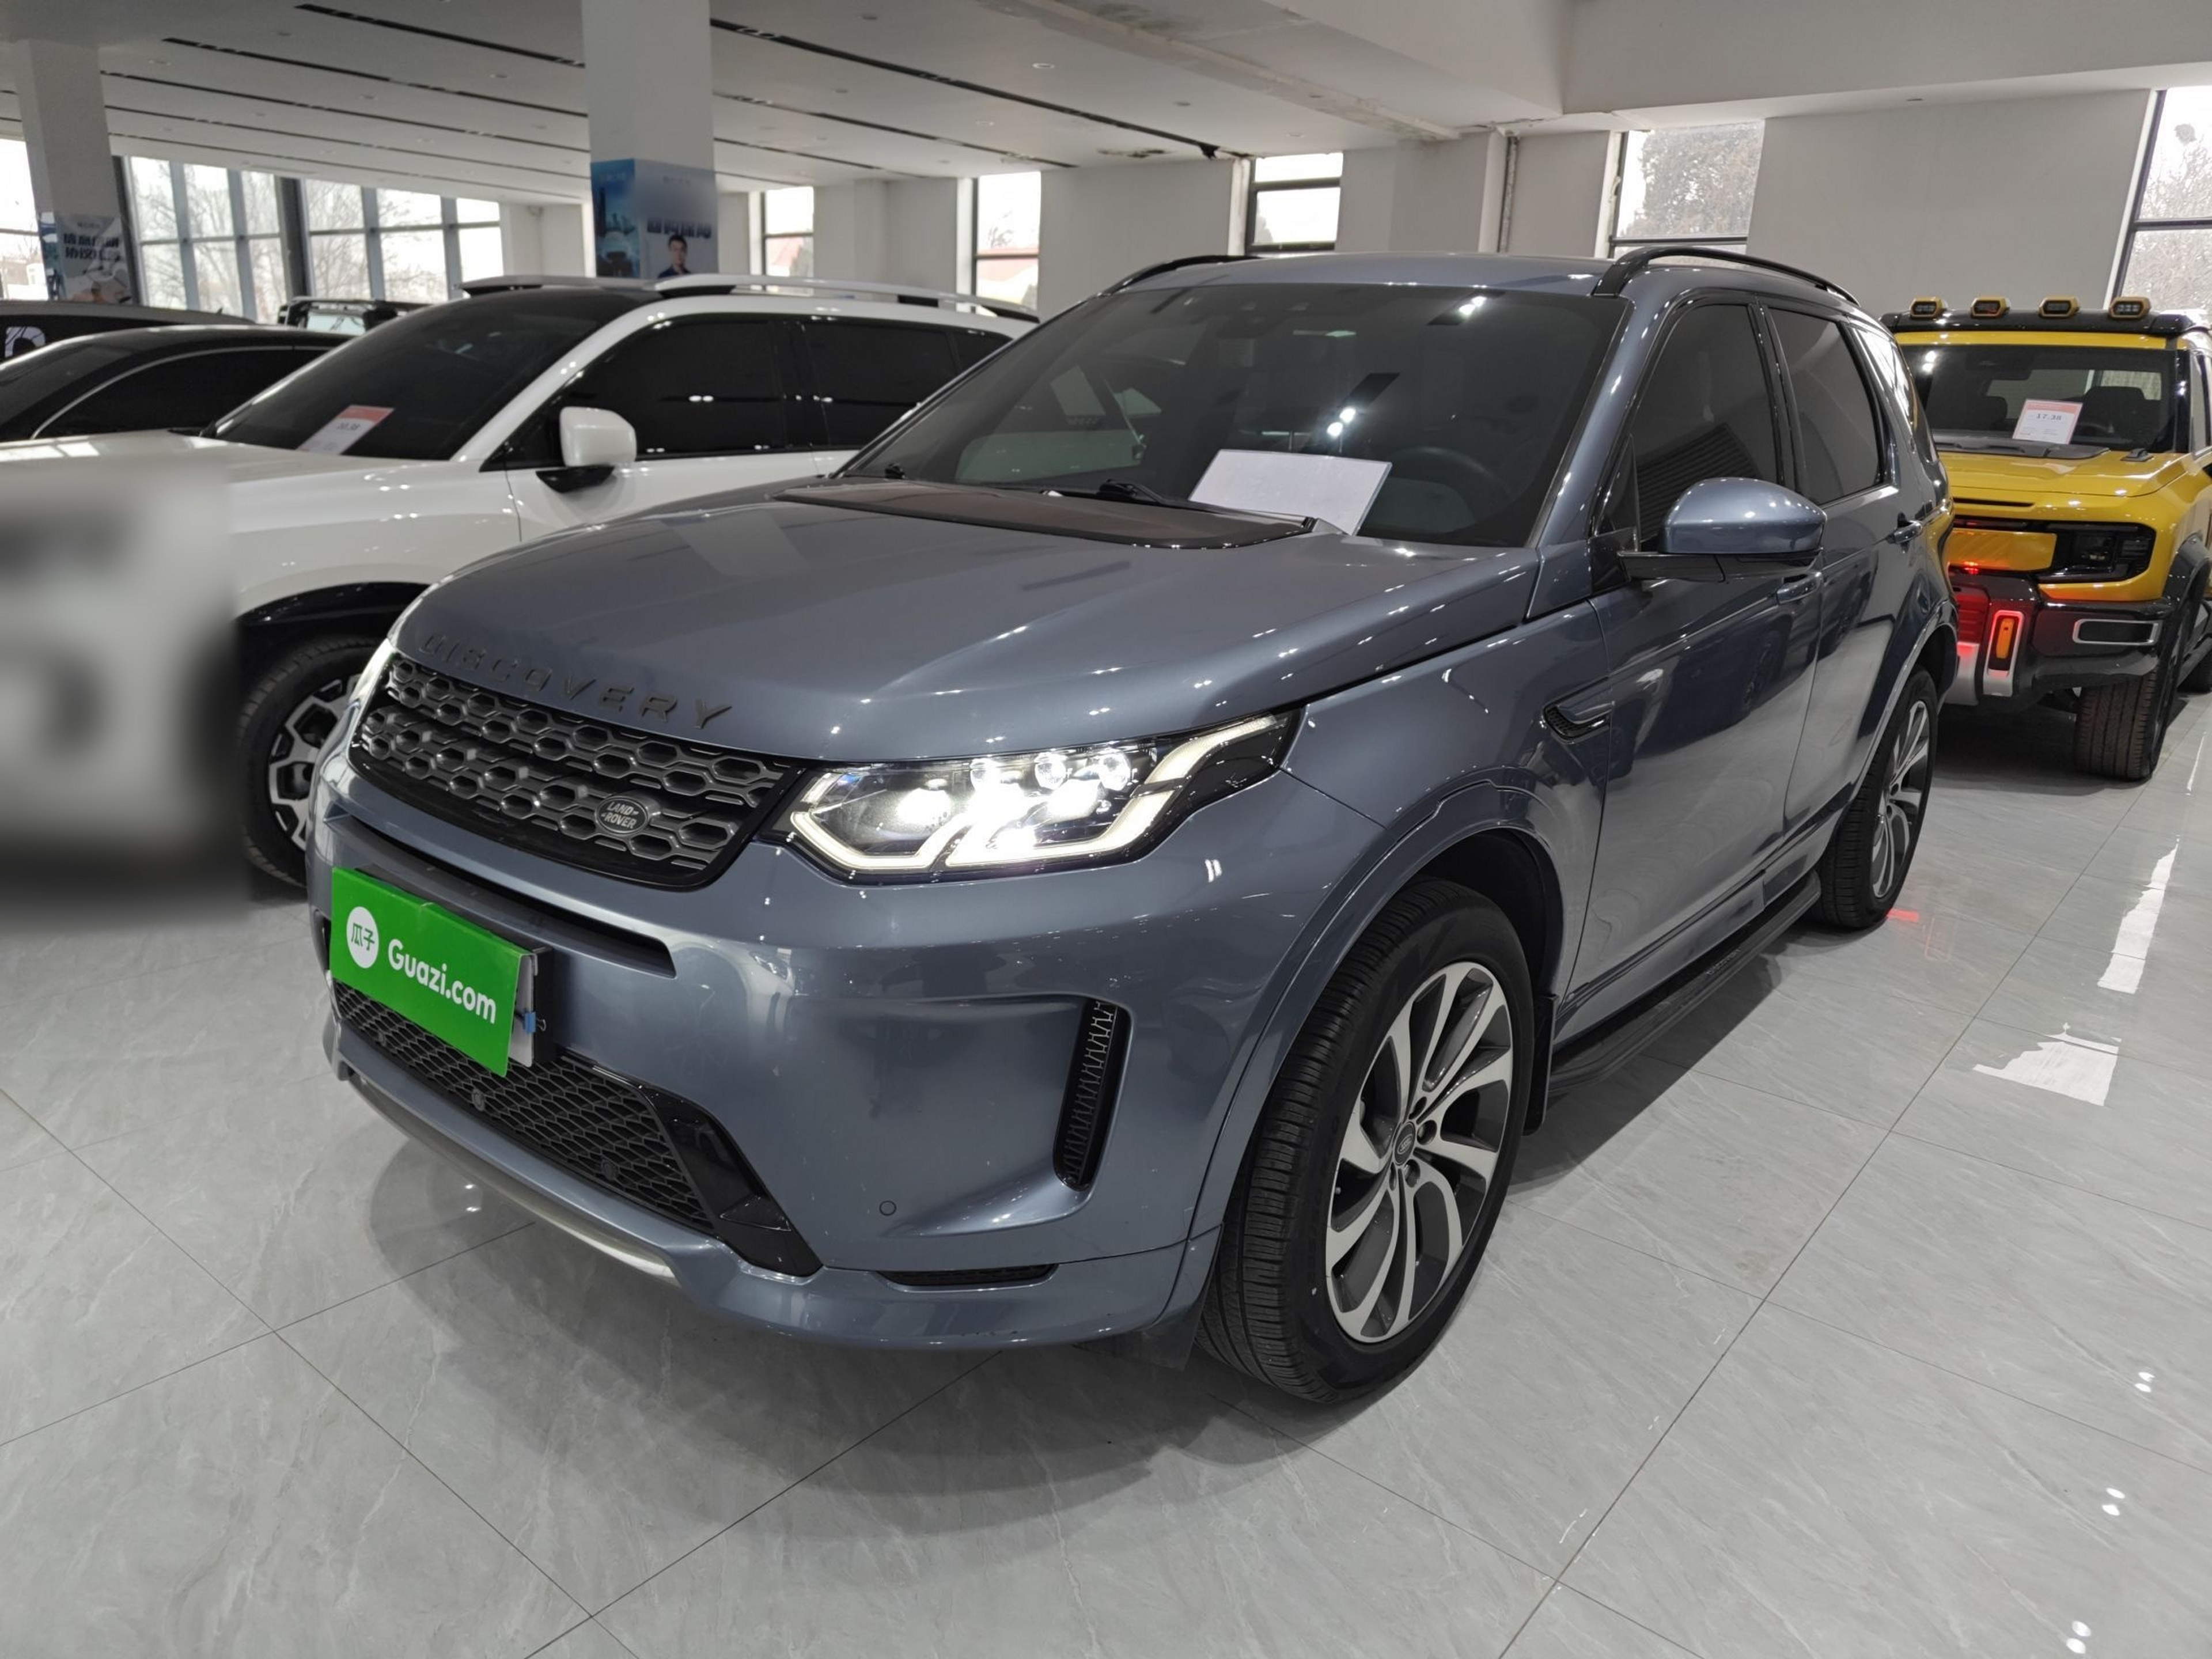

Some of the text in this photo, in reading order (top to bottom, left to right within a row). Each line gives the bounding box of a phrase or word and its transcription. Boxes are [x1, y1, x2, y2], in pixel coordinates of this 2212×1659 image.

[419, 634, 733, 730] DISCOVERY
[604, 812, 637, 829] ROVER
[607, 801, 634, 816] LAND
[351, 922, 375, 951] 瓜子
[388, 938, 497, 1025] Guazi.com
